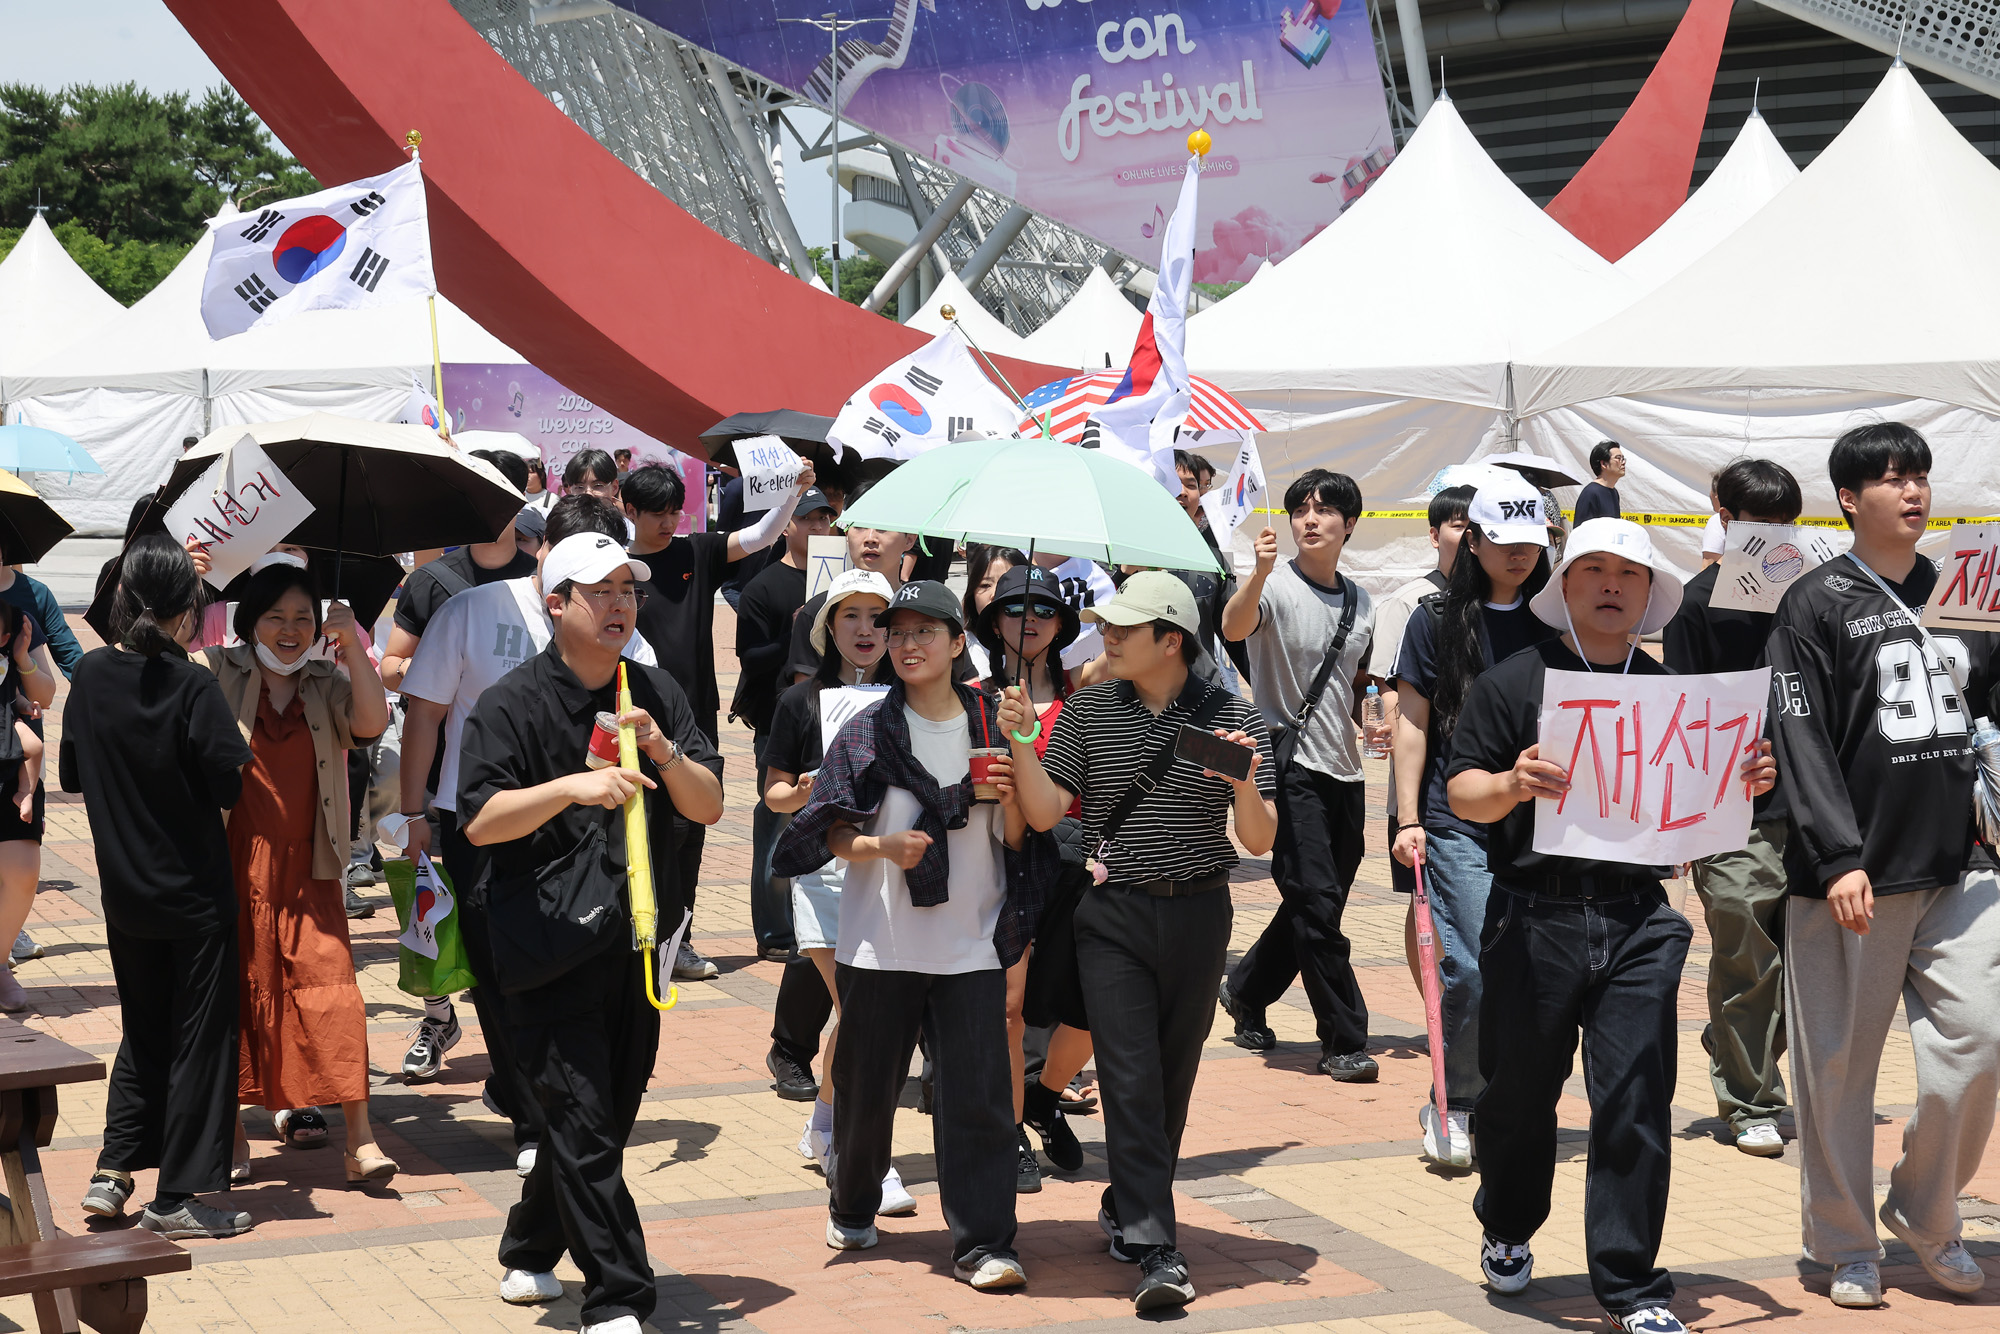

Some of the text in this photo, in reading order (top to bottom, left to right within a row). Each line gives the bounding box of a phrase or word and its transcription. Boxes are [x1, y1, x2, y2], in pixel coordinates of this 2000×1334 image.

[1097, 13, 1196, 63] con
[1058, 60, 1263, 161] festival
[1122, 160, 1233, 181] ONLINE LIVE STAMING
[538, 417, 614, 434] weverse
[747, 446, 797, 468] 재선거
[1498, 500, 1537, 520] PXG
[1846, 614, 1885, 639] DRIX
[1875, 634, 1972, 745] 92
[1557, 692, 1762, 832] 재선거
[1892, 753, 1918, 764] DRIX
[1921, 750, 1941, 760] CLU
[1943, 748, 1960, 758] EST.
